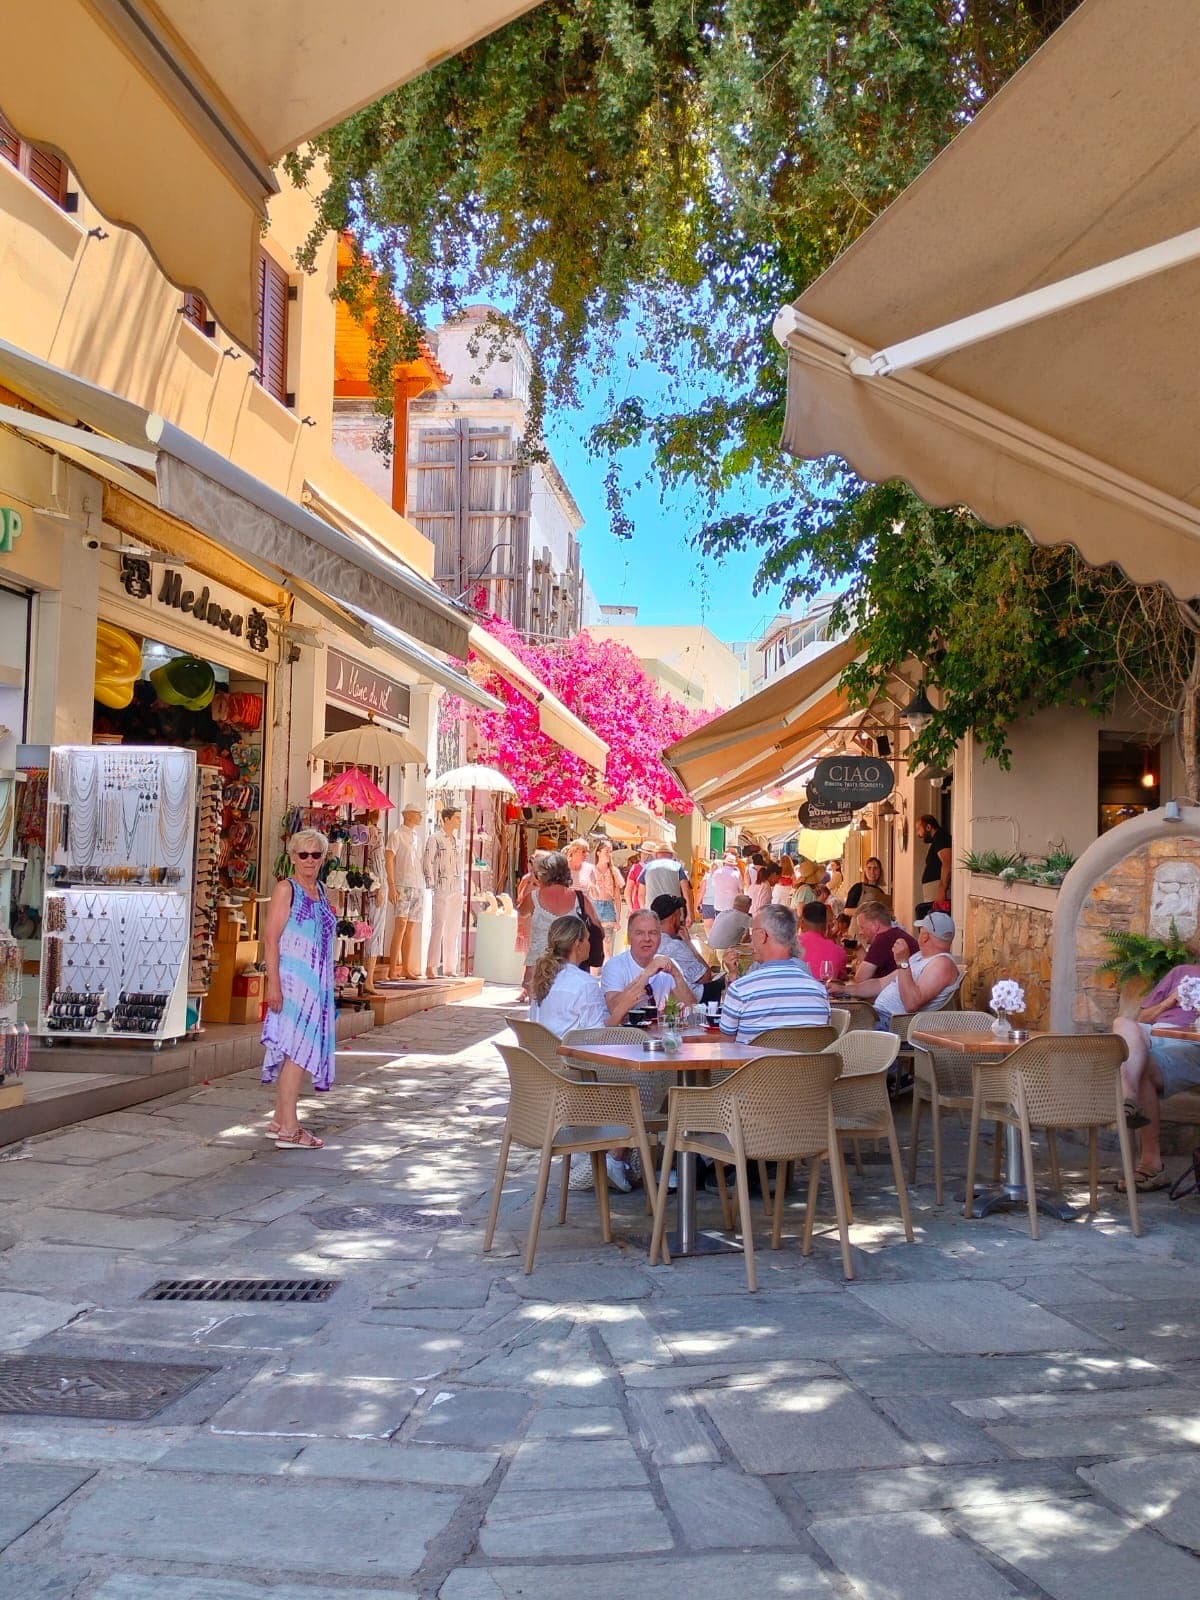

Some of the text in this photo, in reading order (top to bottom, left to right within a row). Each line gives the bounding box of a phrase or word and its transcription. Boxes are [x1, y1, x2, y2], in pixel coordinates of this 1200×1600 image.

[158, 570, 244, 637] Medusa
[369, 681, 378, 706] du
[829, 765, 880, 782] CIAO
